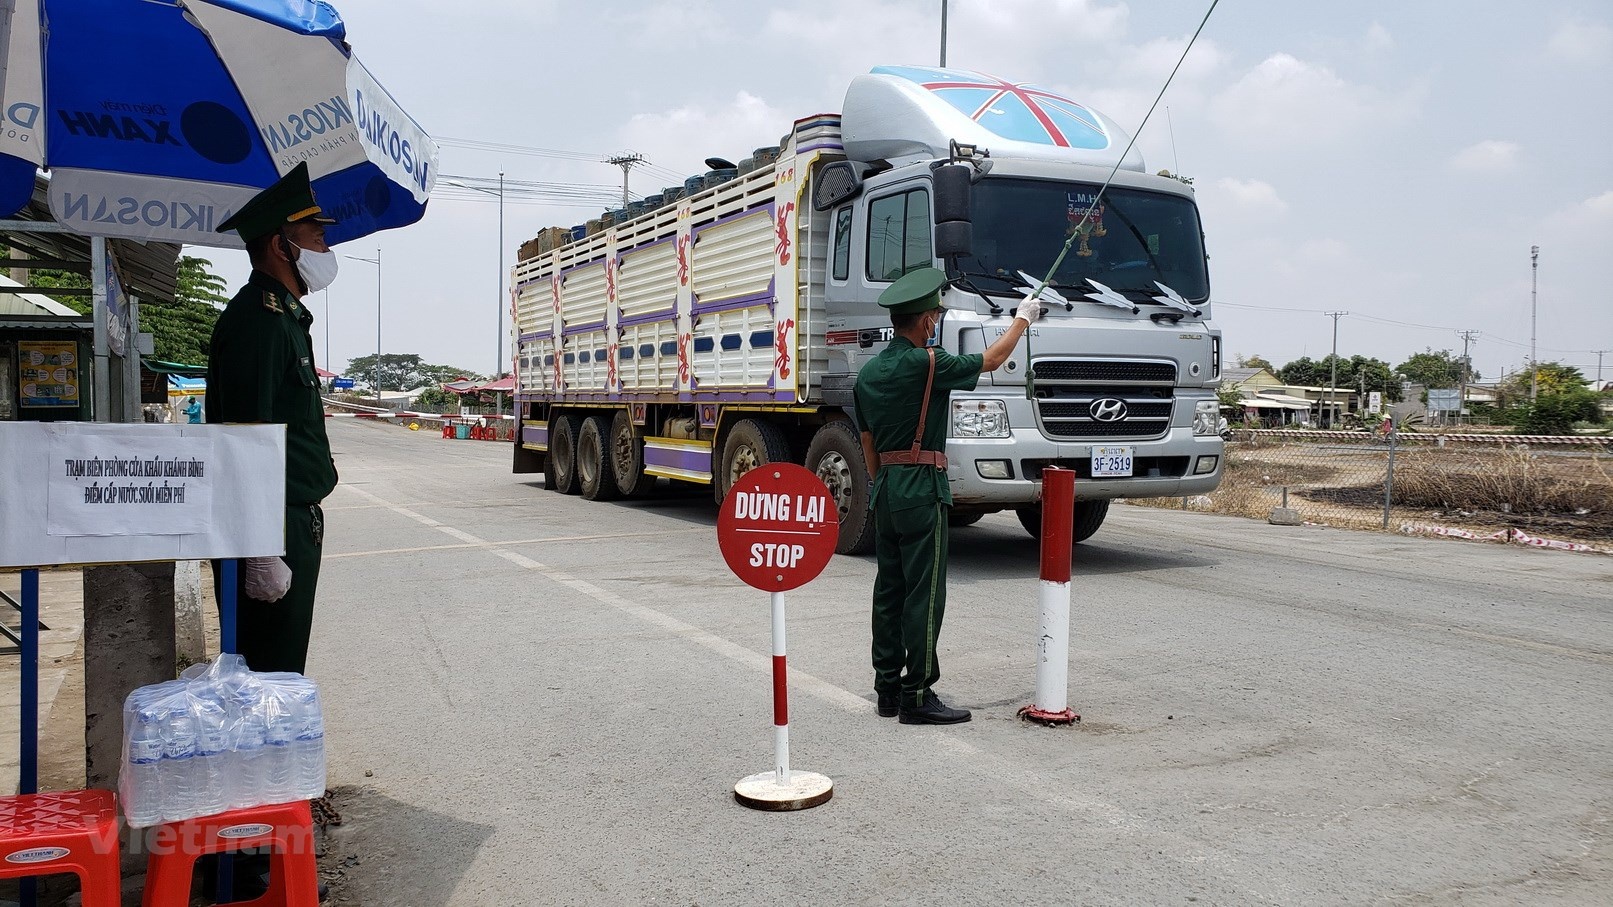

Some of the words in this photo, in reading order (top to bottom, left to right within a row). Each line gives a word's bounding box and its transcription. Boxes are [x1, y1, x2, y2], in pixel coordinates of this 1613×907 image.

[356, 89, 429, 192] DAIKIOSAN
[775, 167, 794, 187] 168
[677, 206, 690, 220] 168
[879, 327, 895, 341] TR
[65, 459, 86, 481] TRẠM
[87, 455, 103, 477] BIÊN
[104, 455, 128, 477] PHÒNG
[164, 457, 187, 477] KHÁNH
[188, 457, 204, 477] BÌNH
[1094, 457, 1131, 471] 3F-2519
[174, 482, 186, 504] PHÍ
[735, 485, 790, 521] DỪNG
[796, 495, 826, 528] LẠI
[749, 542, 805, 569] STOP
